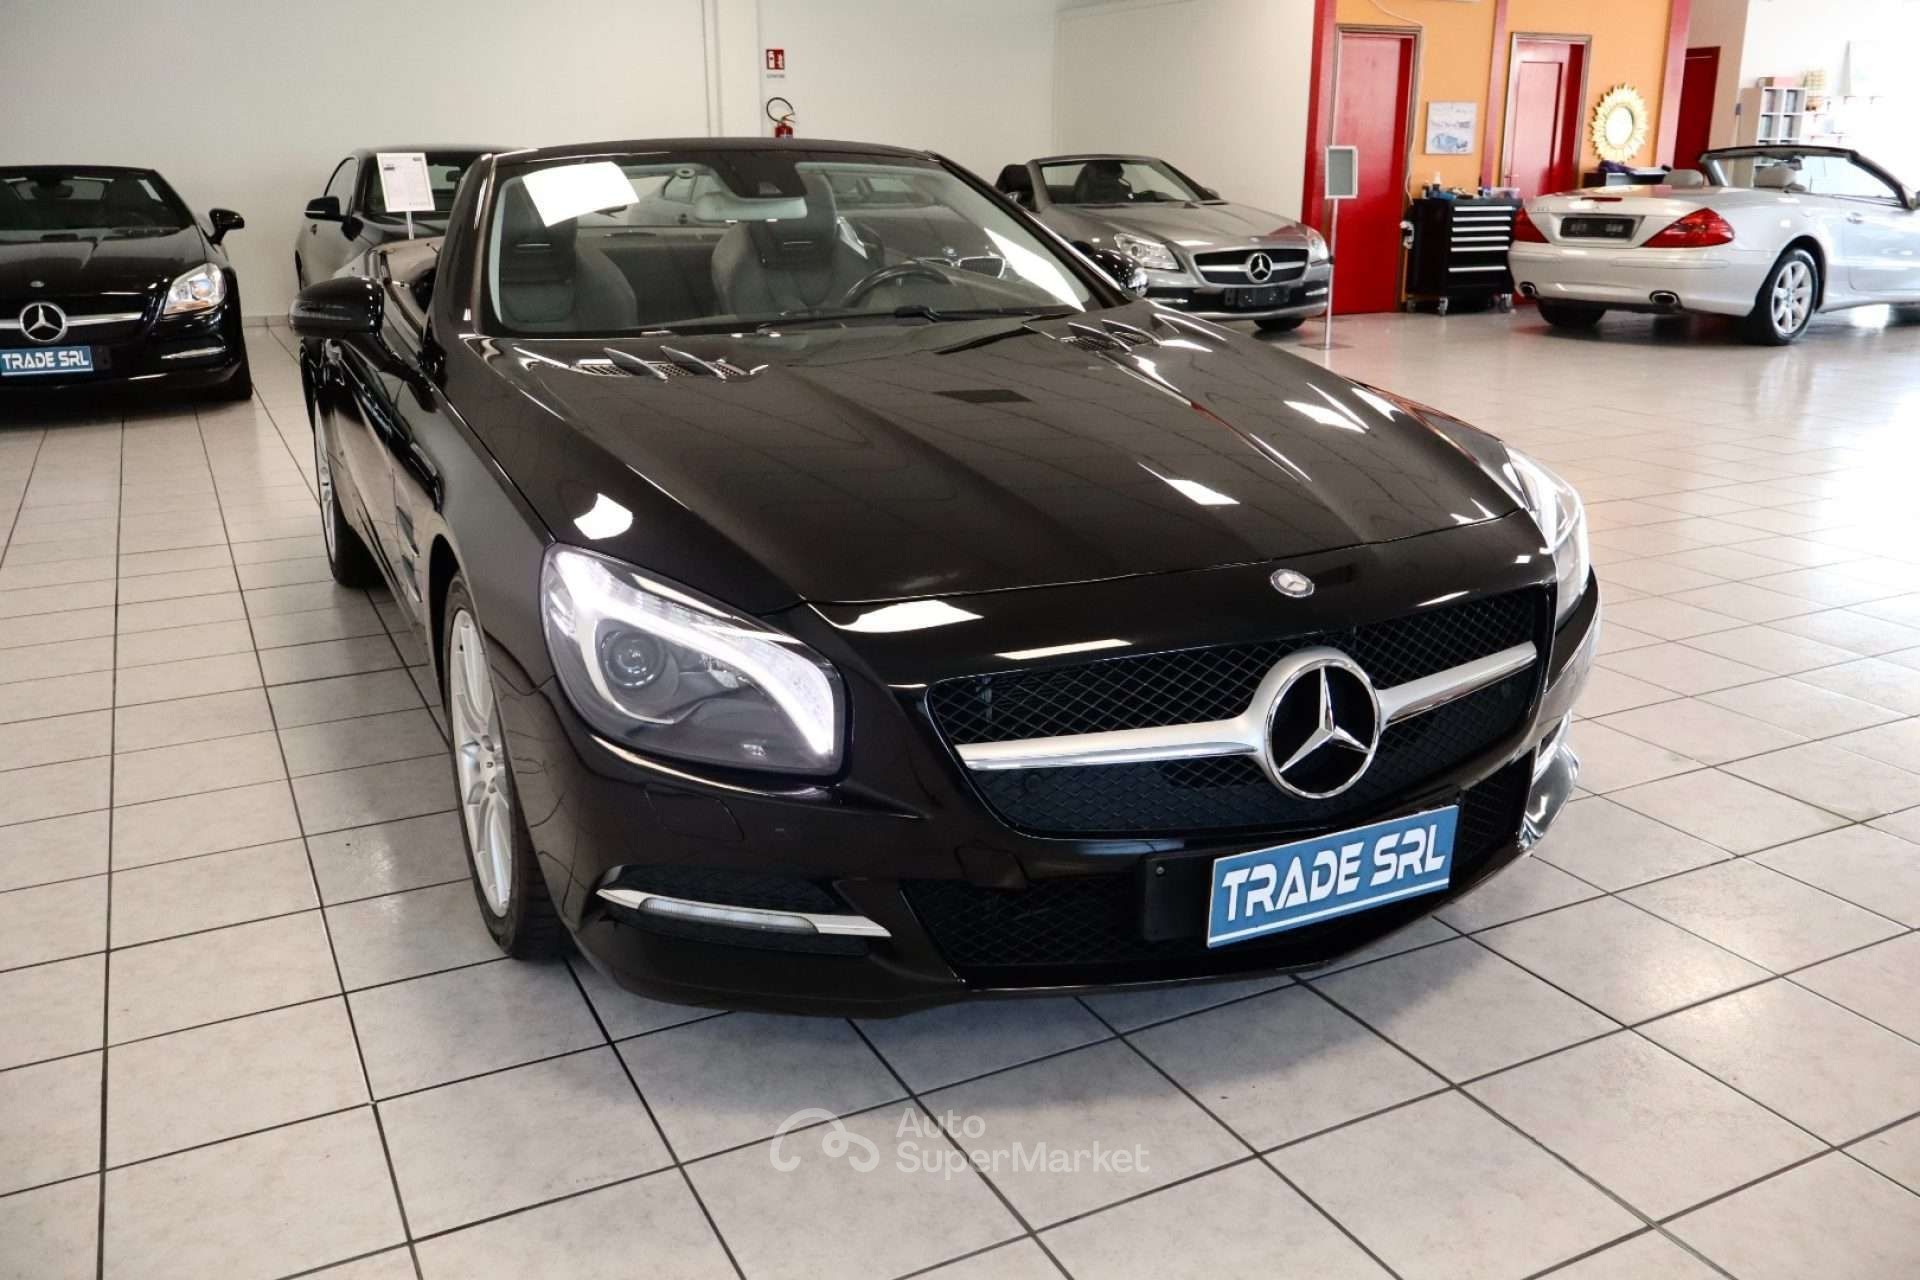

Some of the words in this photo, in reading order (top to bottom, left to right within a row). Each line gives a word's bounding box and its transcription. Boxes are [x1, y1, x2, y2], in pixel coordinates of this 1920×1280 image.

[2, 351, 55, 370] TRADE
[57, 350, 90, 367] SRL
[1221, 841, 1365, 922] TRADE
[1369, 824, 1446, 887] SRL
